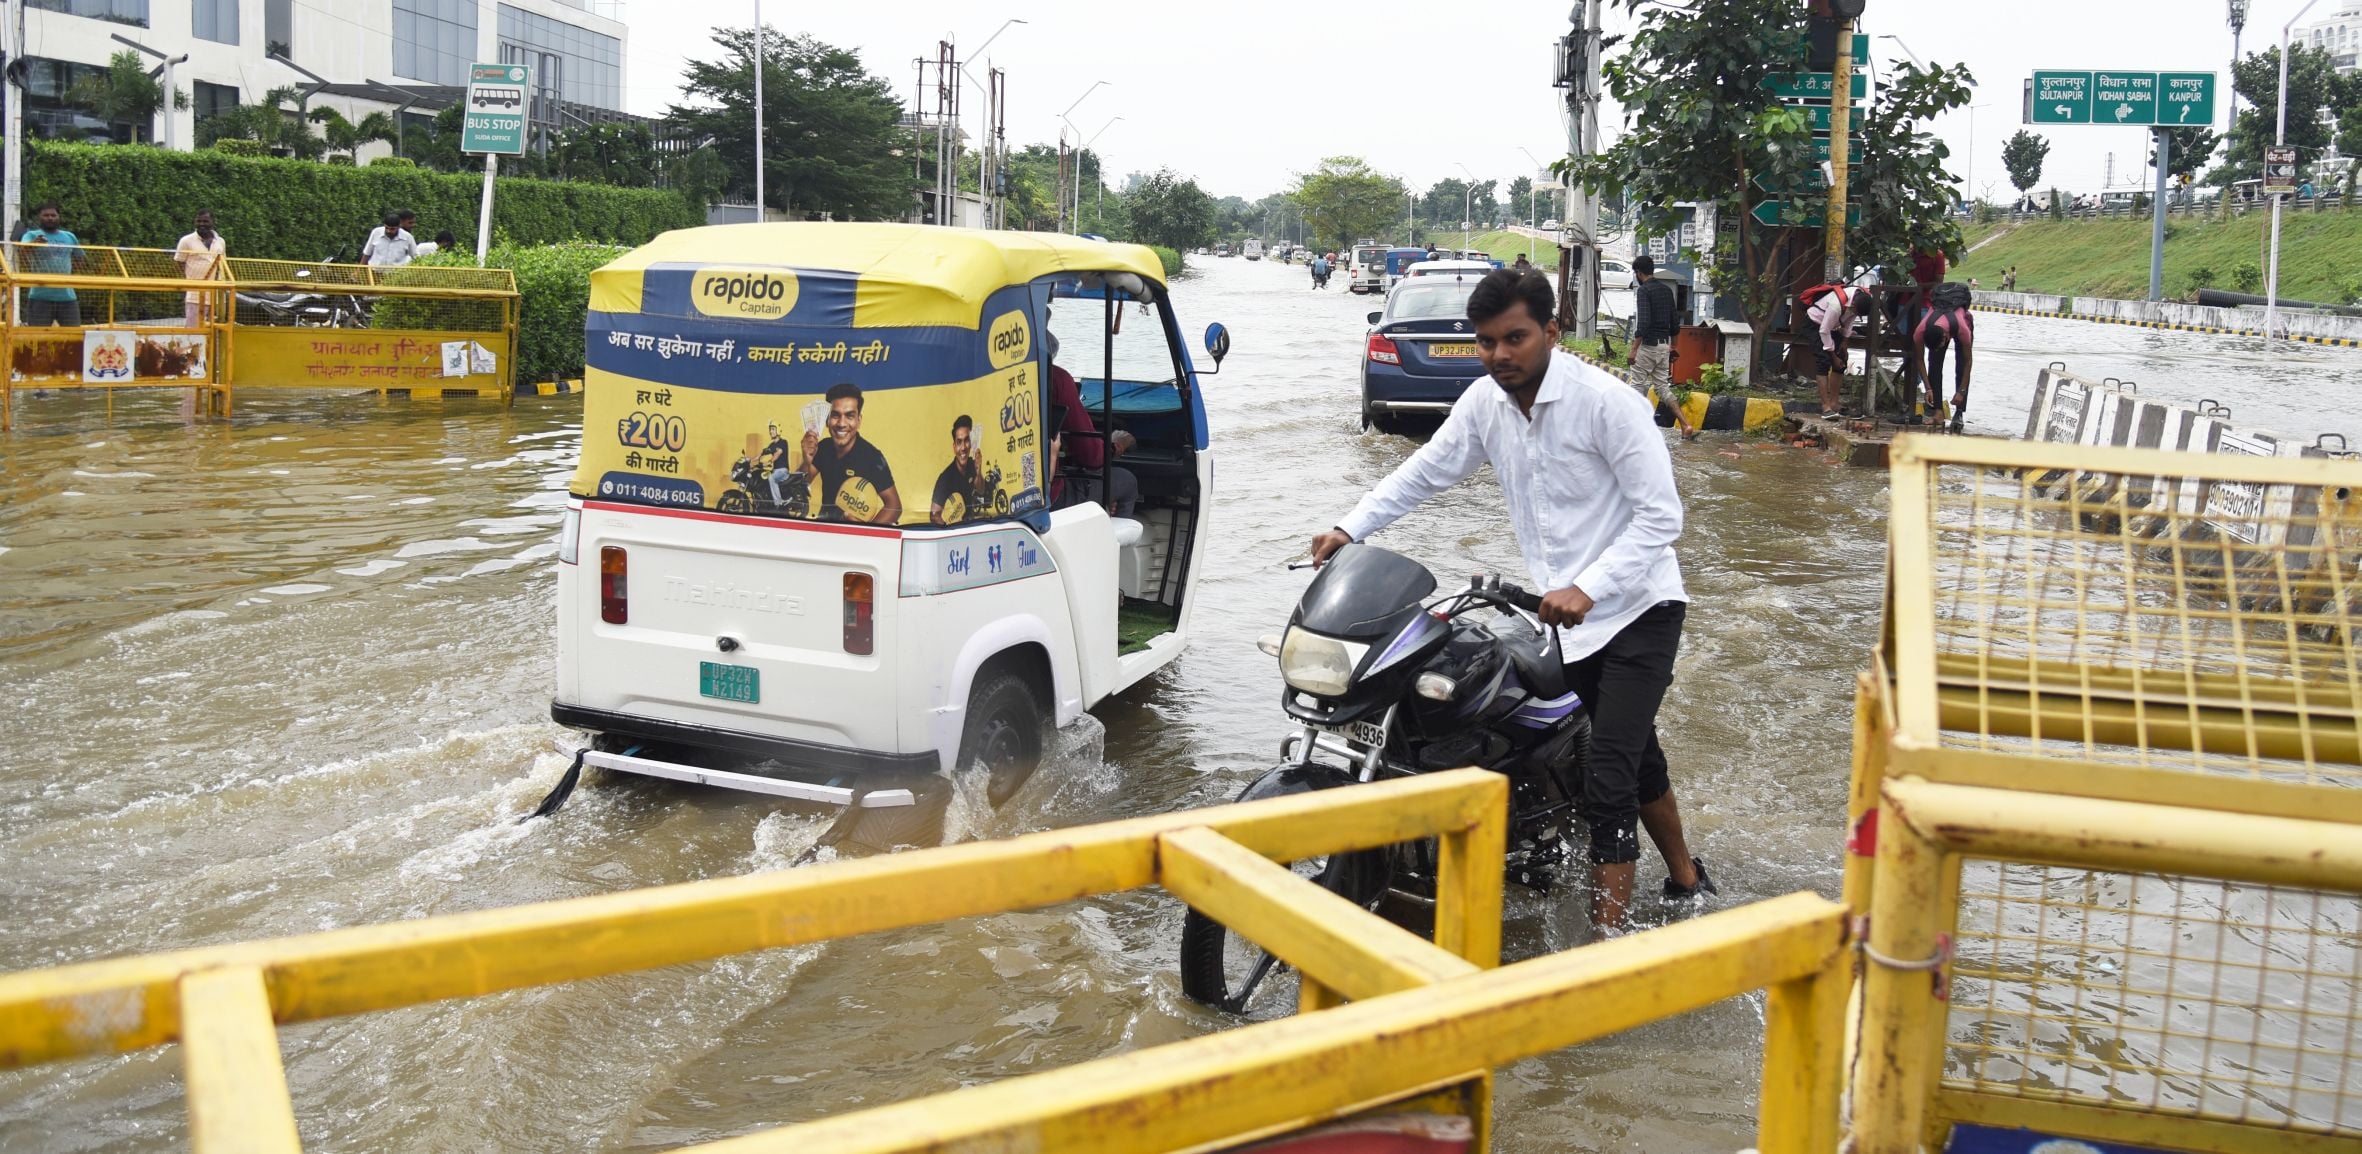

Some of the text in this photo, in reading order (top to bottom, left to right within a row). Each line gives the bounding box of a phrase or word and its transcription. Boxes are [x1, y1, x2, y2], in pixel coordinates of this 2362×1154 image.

[2040, 77, 2086, 90] सुल्तानपुर
[2099, 75, 2152, 88] विधान सभा
[2170, 79, 2204, 91] कानपुर
[2039, 90, 2084, 101] SULTANPUR
[2098, 91, 2152, 102] VIDHAN SABHA
[2168, 92, 2202, 102] KANPUR
[467, 118, 521, 131] BUS STOP
[704, 273, 785, 304] rapido
[739, 301, 782, 315] Captain
[608, 330, 632, 348] अब
[634, 333, 656, 351] सर
[658, 334, 703, 359] झुकेगा
[706, 339, 736, 362] नहीं
[747, 341, 796, 366] कमाई
[798, 342, 848, 364] रुकेगी
[994, 322, 1024, 356] rapido
[636, 389, 673, 406] हर घंटे
[1001, 390, 1034, 433] ₹200
[618, 411, 687, 452] ₹200
[626, 451, 680, 474] की गारंटी
[616, 483, 701, 504] 011 4084 6045
[839, 490, 871, 513] rapido
[947, 545, 971, 576] Sirf
[663, 576, 806, 617] Mahindra
[1355, 722, 1384, 747] 4936
